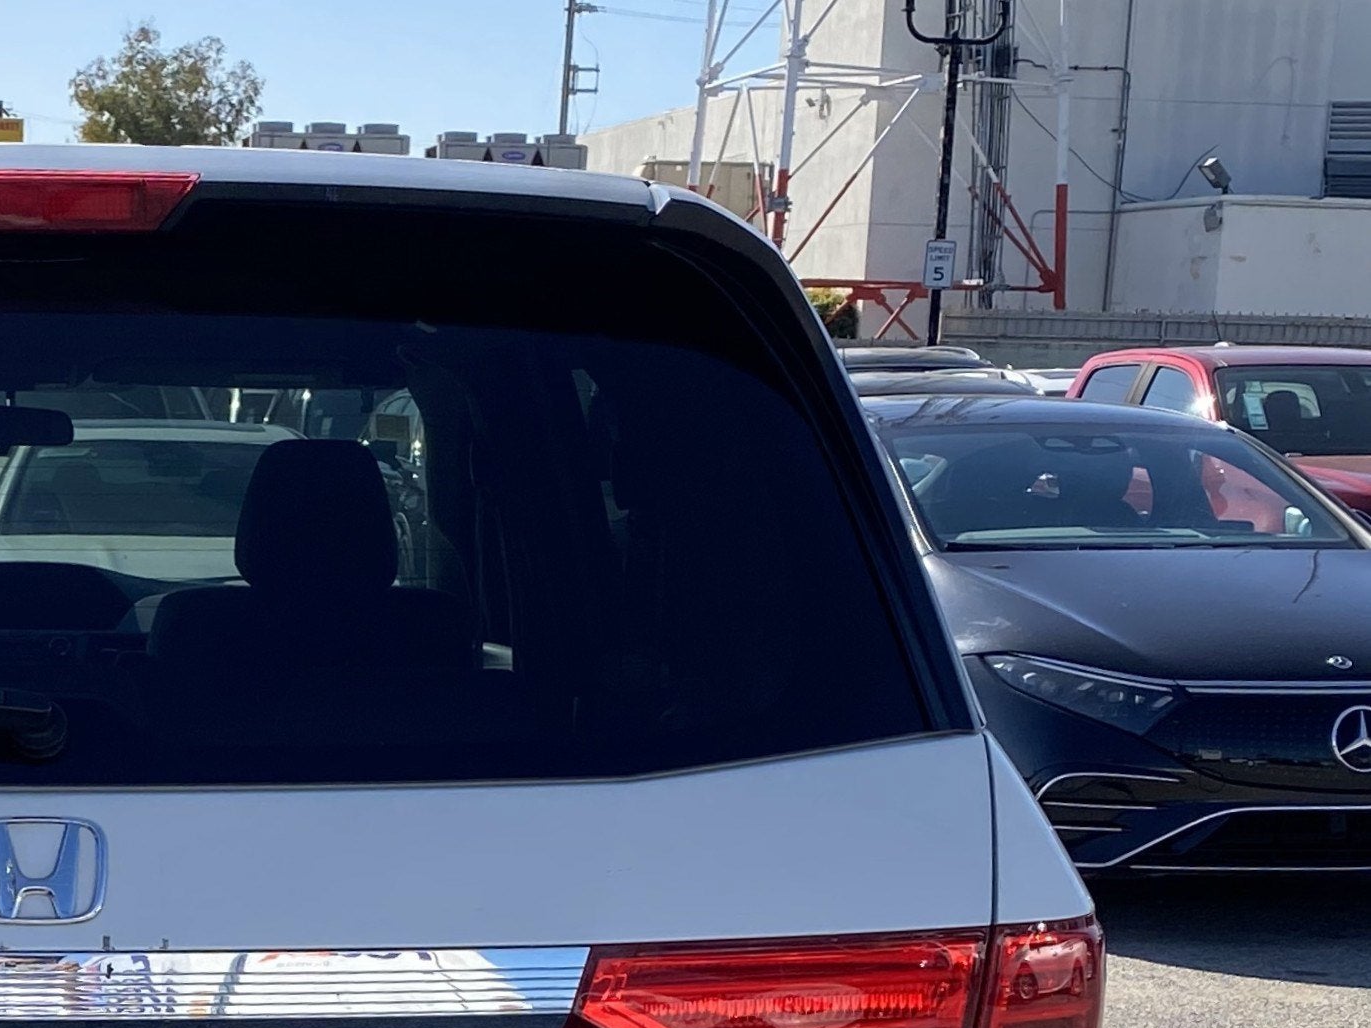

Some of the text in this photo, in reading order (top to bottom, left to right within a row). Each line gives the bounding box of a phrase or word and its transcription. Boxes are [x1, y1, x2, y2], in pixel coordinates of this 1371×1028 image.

[928, 246, 954, 254] SPEED
[929, 254, 950, 262] LIMIT
[933, 266, 945, 281] 5
